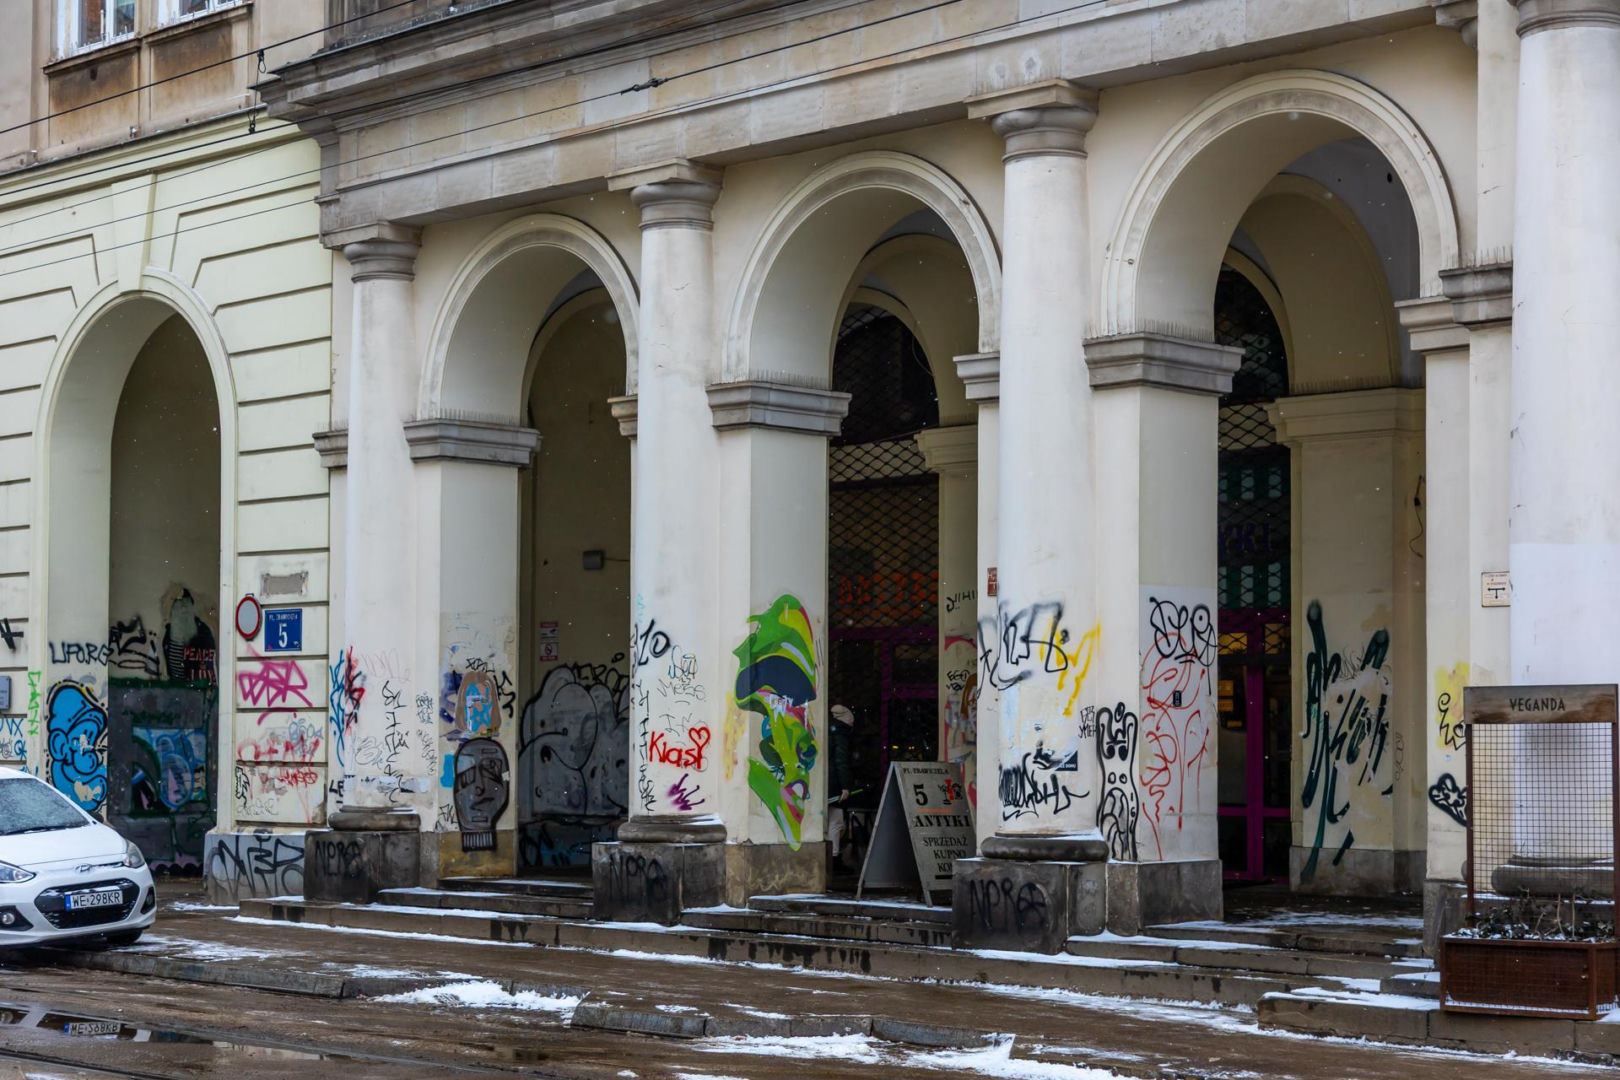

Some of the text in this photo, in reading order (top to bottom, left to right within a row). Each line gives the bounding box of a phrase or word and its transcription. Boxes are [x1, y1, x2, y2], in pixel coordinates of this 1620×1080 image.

[278, 623, 288, 649] 5
[1509, 697, 1566, 712] VEGANDA
[913, 783, 929, 806] 5
[913, 815, 971, 828] ANTYKI
[922, 834, 969, 847] SPRZEDAŻ
